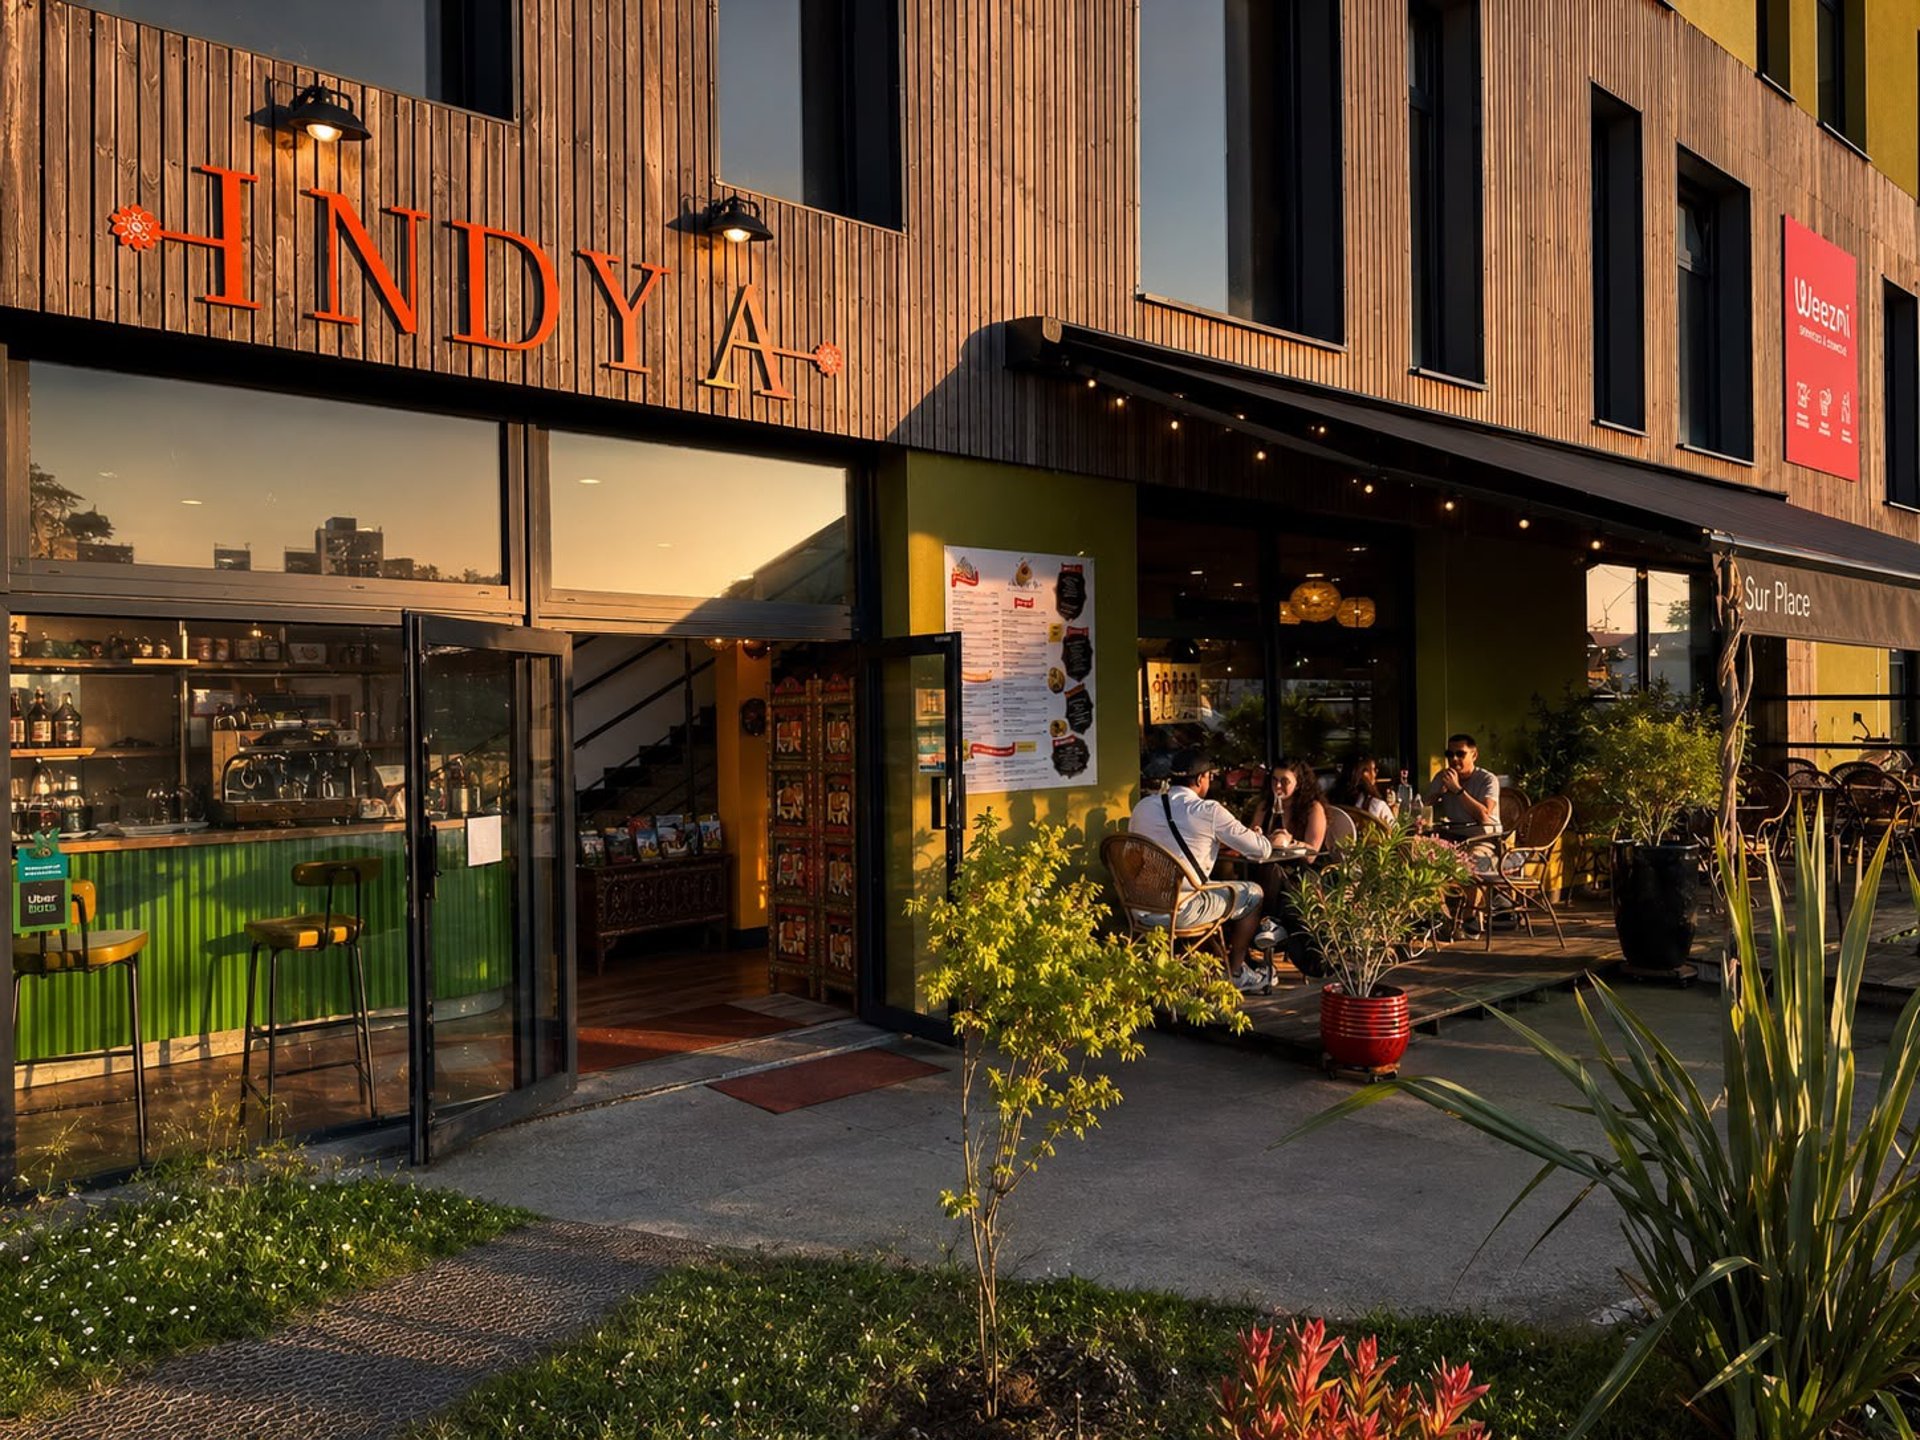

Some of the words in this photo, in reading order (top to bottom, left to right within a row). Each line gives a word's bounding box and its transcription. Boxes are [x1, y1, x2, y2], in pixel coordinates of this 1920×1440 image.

[160, 163, 816, 401] INDYA
[1744, 575, 1771, 612] Sur
[1774, 580, 1811, 617] Place
[28, 894, 58, 904] Uber
